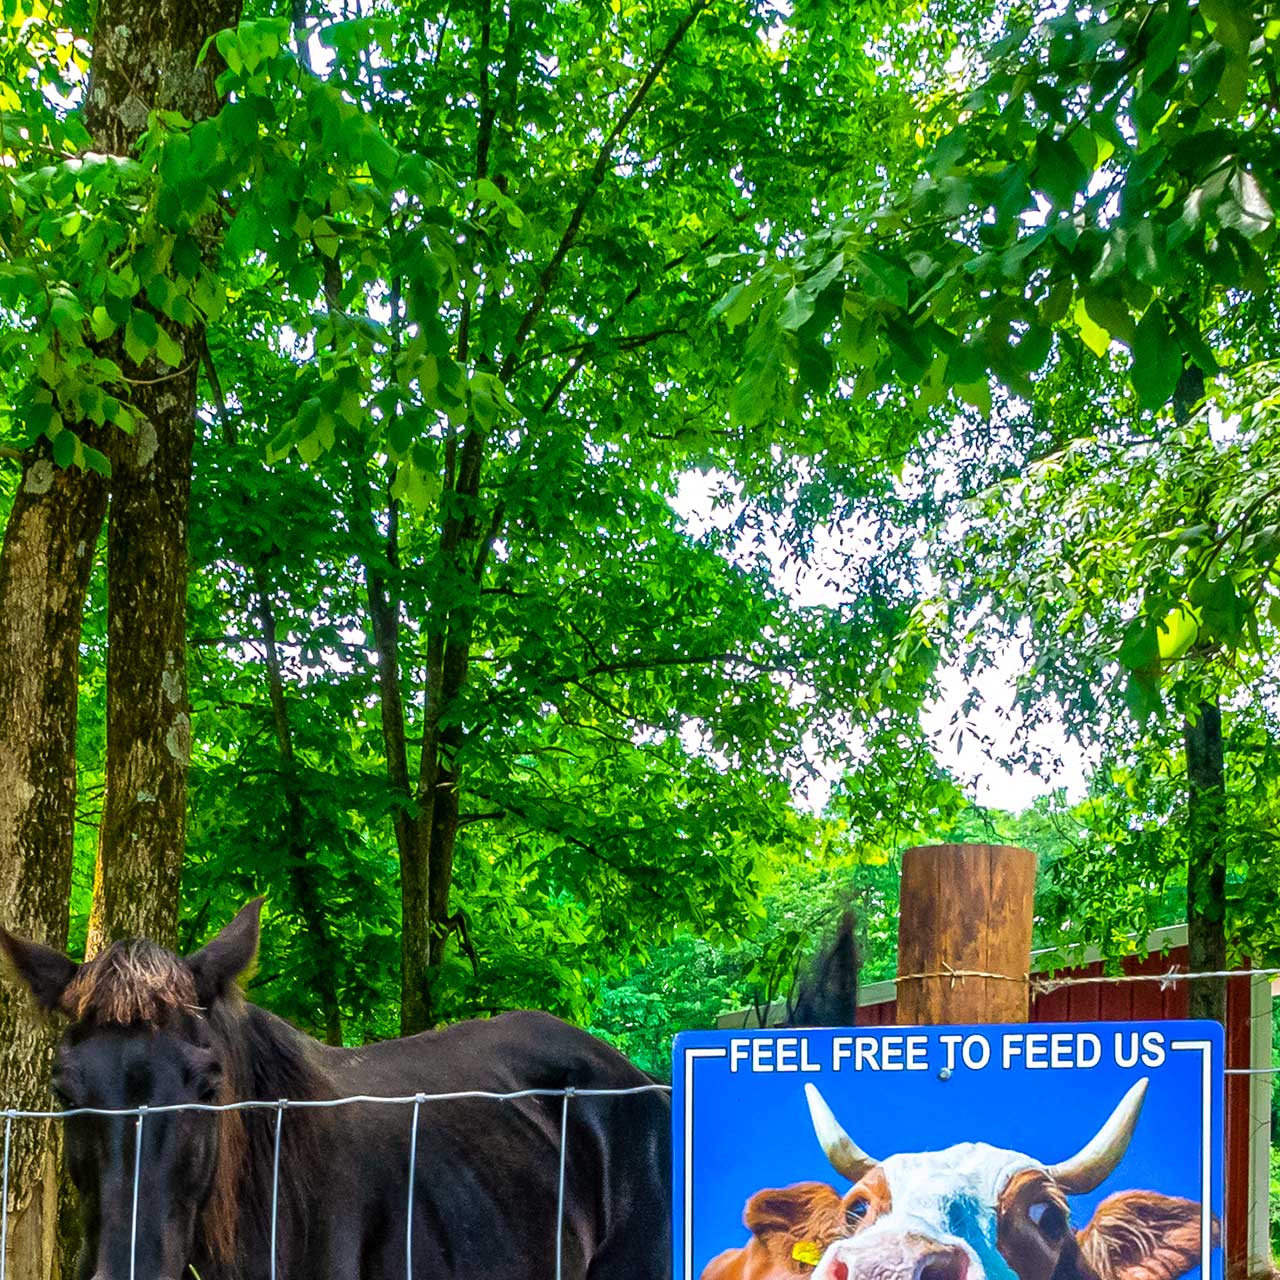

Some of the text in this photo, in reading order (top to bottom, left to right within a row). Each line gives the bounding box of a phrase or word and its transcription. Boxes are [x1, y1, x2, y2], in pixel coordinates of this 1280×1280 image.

[730, 1032, 1166, 1072] FEEL FREE TO FEED US
